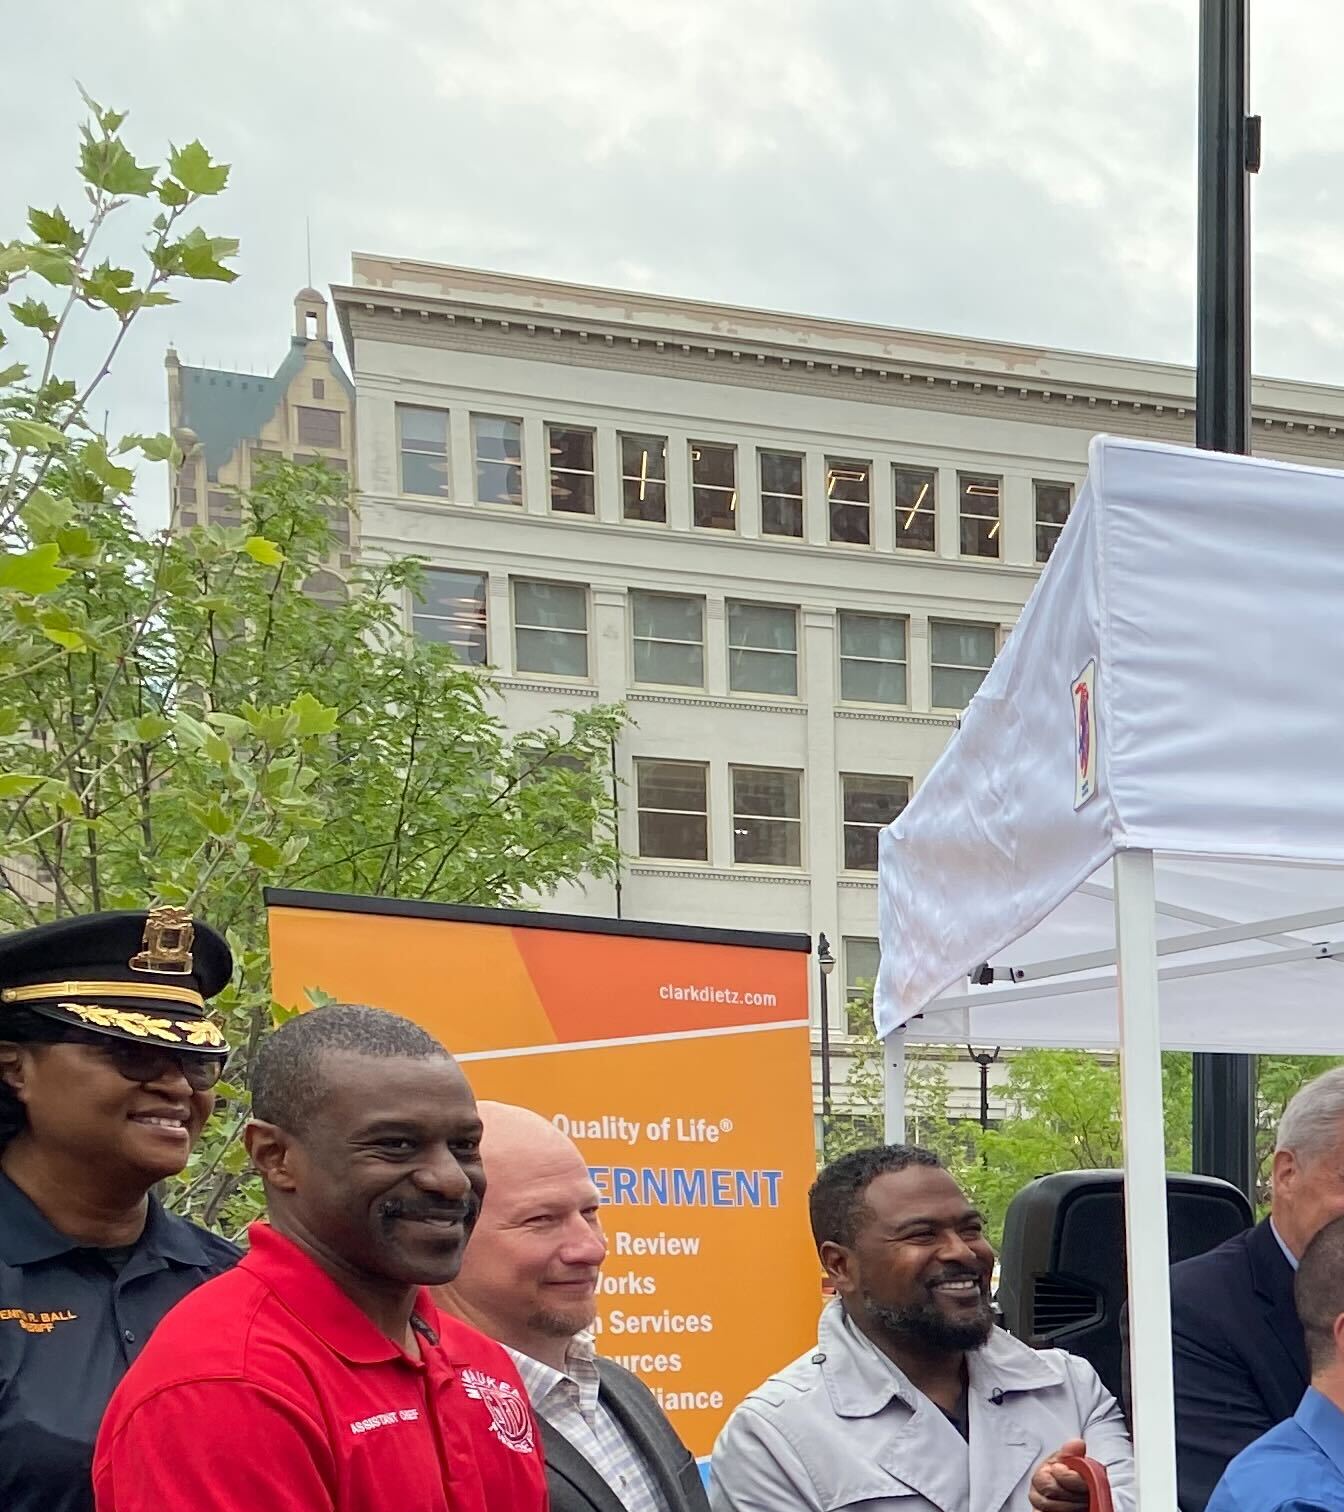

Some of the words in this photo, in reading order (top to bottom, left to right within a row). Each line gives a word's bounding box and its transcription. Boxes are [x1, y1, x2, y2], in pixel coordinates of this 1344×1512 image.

[659, 983, 776, 1007] clarkdietz.com
[552, 1113, 640, 1146] Quality
[646, 1116, 671, 1142] of
[587, 1166, 783, 1208] ERNMENT
[615, 1231, 700, 1256] Review
[40, 1310, 78, 1323] BALL
[609, 1309, 713, 1334] Services
[602, 1353, 682, 1374] urces
[647, 1387, 724, 1411] iance
[350, 1411, 399, 1435] ASSISTANT
